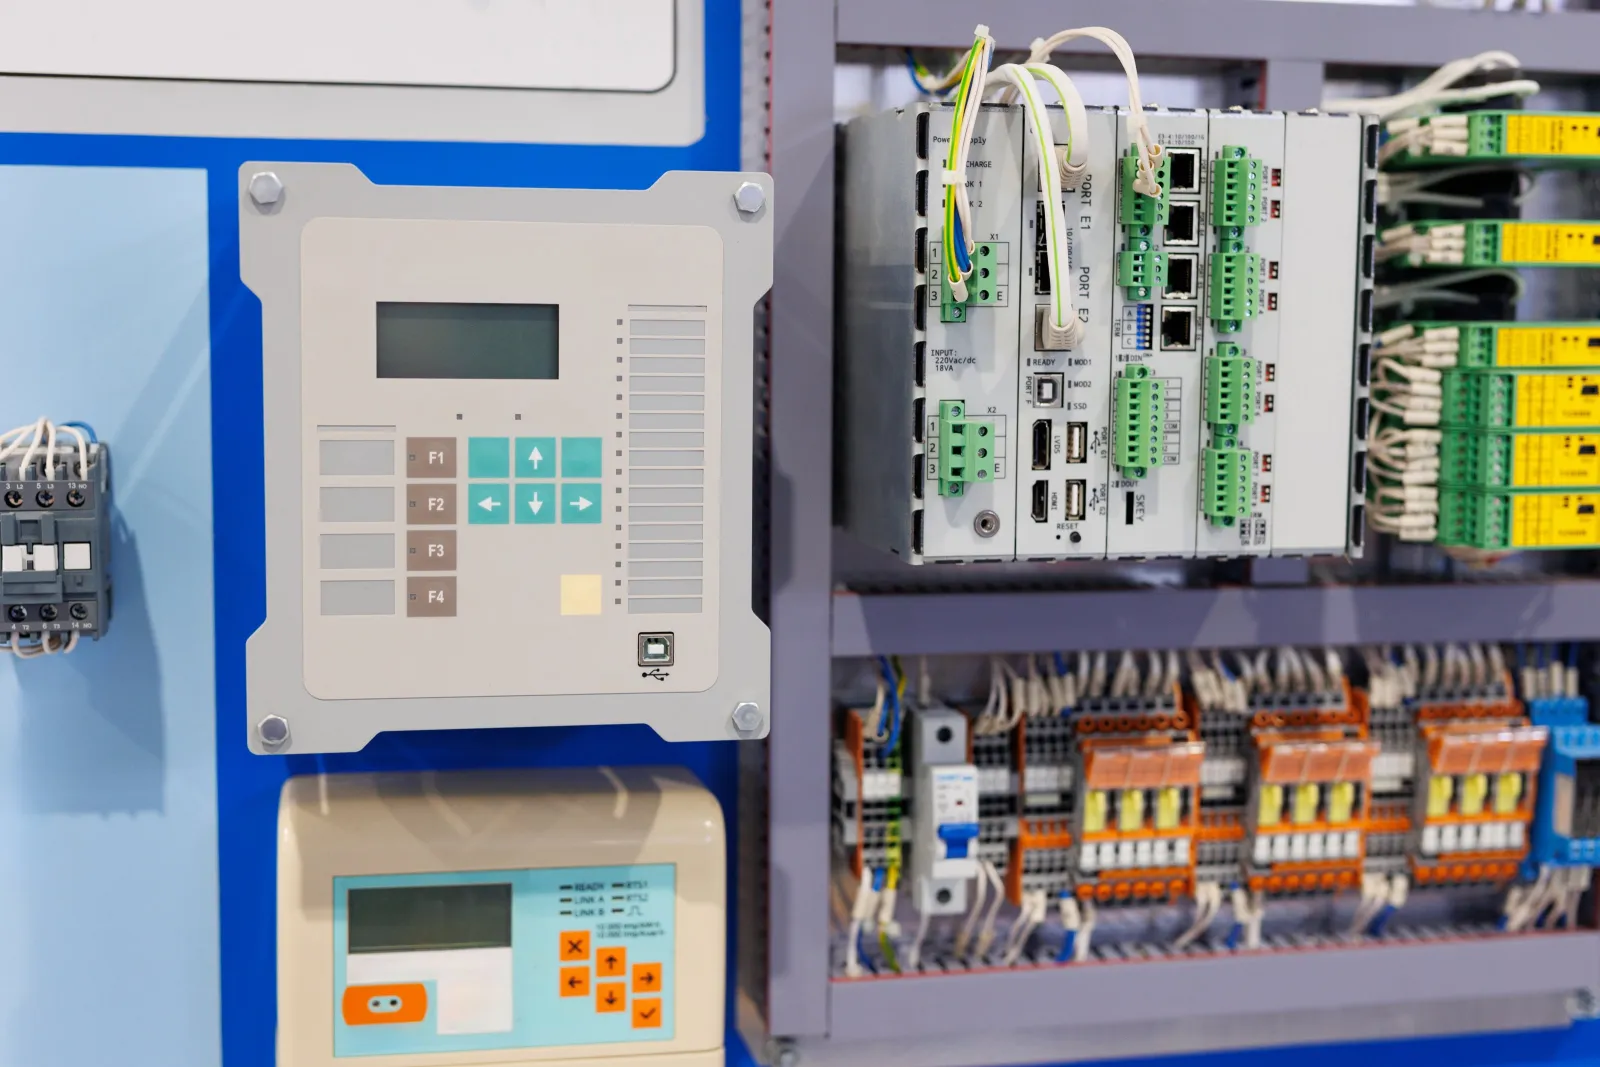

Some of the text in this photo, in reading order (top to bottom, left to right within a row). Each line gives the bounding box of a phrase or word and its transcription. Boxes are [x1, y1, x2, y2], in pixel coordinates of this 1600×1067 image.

[965, 160, 992, 168] CHARGE
[1080, 174, 1092, 230] PORT E1
[932, 248, 937, 258] 1
[931, 269, 938, 280] 2
[931, 290, 1003, 301] 3 E
[1078, 266, 1090, 323] PORT E2
[1126, 323, 1132, 331] B
[1126, 338, 1132, 346] C
[931, 349, 957, 357] INPUT:
[1130, 354, 1142, 362] DIN
[935, 356, 976, 364] 220Vac/dc
[1032, 358, 1056, 366] READY
[1073, 380, 1092, 388] MOD2
[1073, 402, 1087, 410] SSD
[930, 422, 935, 432] 1
[929, 443, 936, 453] 2
[428, 451, 444, 465] F1
[1100, 450, 1107, 459] G1
[929, 463, 1001, 474] 3 E
[1121, 480, 1139, 488] DOUT
[428, 497, 445, 511] F2
[1050, 491, 1058, 511] HDMI
[1099, 506, 1106, 516] G2
[1135, 494, 1145, 522] SKEY
[1056, 522, 1079, 530] RESET
[428, 544, 445, 557] F3
[428, 590, 445, 604] F4
